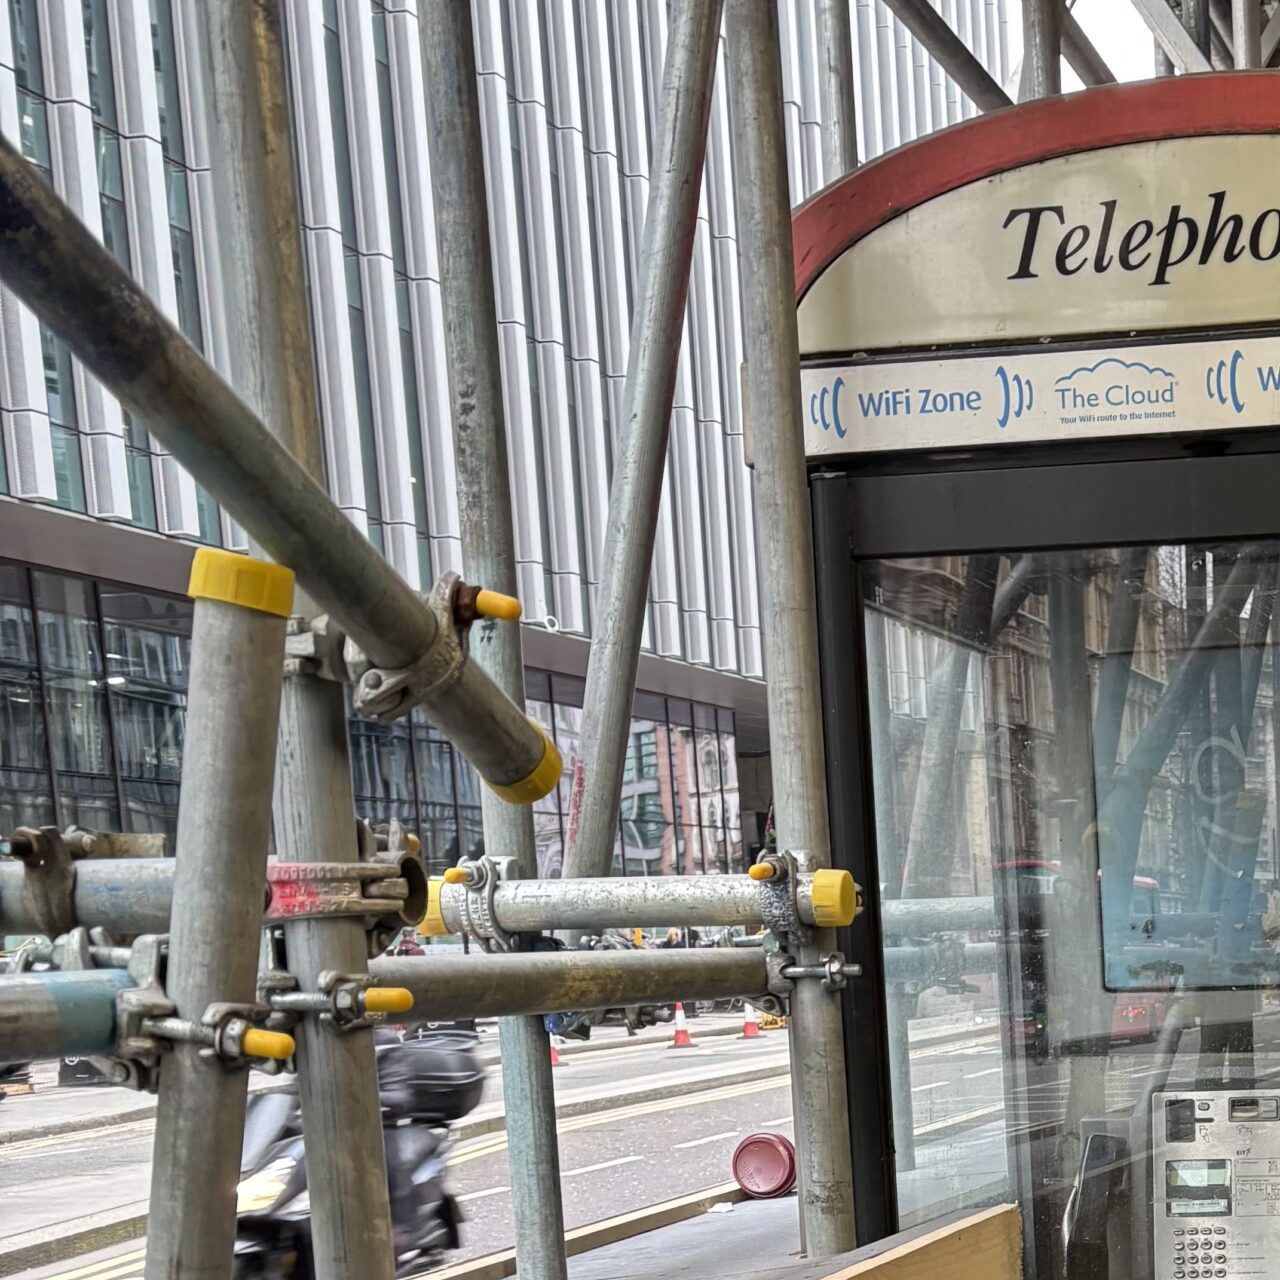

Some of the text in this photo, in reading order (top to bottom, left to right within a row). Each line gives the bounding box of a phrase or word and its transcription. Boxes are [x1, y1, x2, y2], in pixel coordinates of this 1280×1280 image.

[858, 388, 982, 417] WiFi Zone
[1055, 382, 1174, 409] The Cloud
[1060, 410, 1175, 424] Your WiFi route to the Internet
